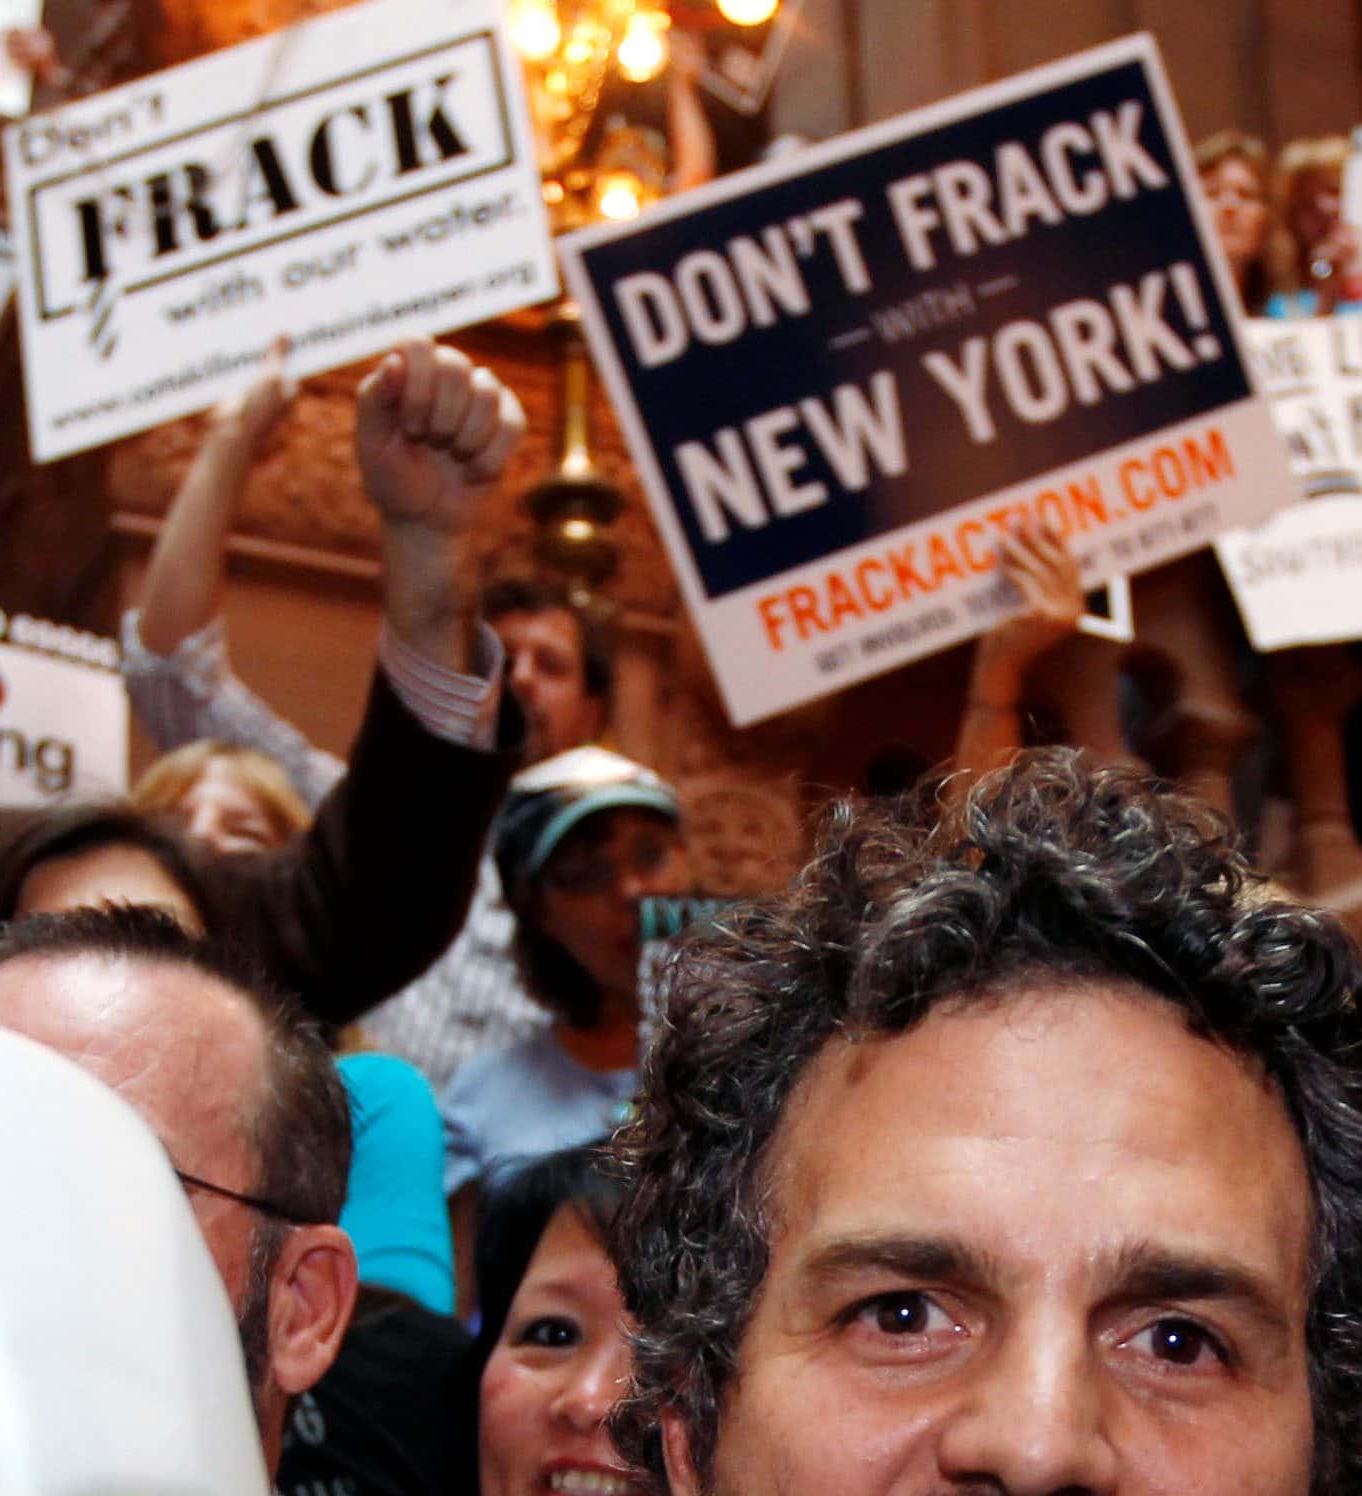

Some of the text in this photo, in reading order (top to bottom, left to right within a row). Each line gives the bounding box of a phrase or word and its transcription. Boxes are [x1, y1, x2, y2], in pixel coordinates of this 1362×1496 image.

[18, 92, 168, 166] Don't
[72, 70, 475, 284] FRACK
[613, 101, 1170, 369] DON'T FRACK
[164, 263, 265, 325] with
[277, 243, 364, 290] our
[672, 369, 909, 544] NEW
[923, 262, 1224, 444] YORK!
